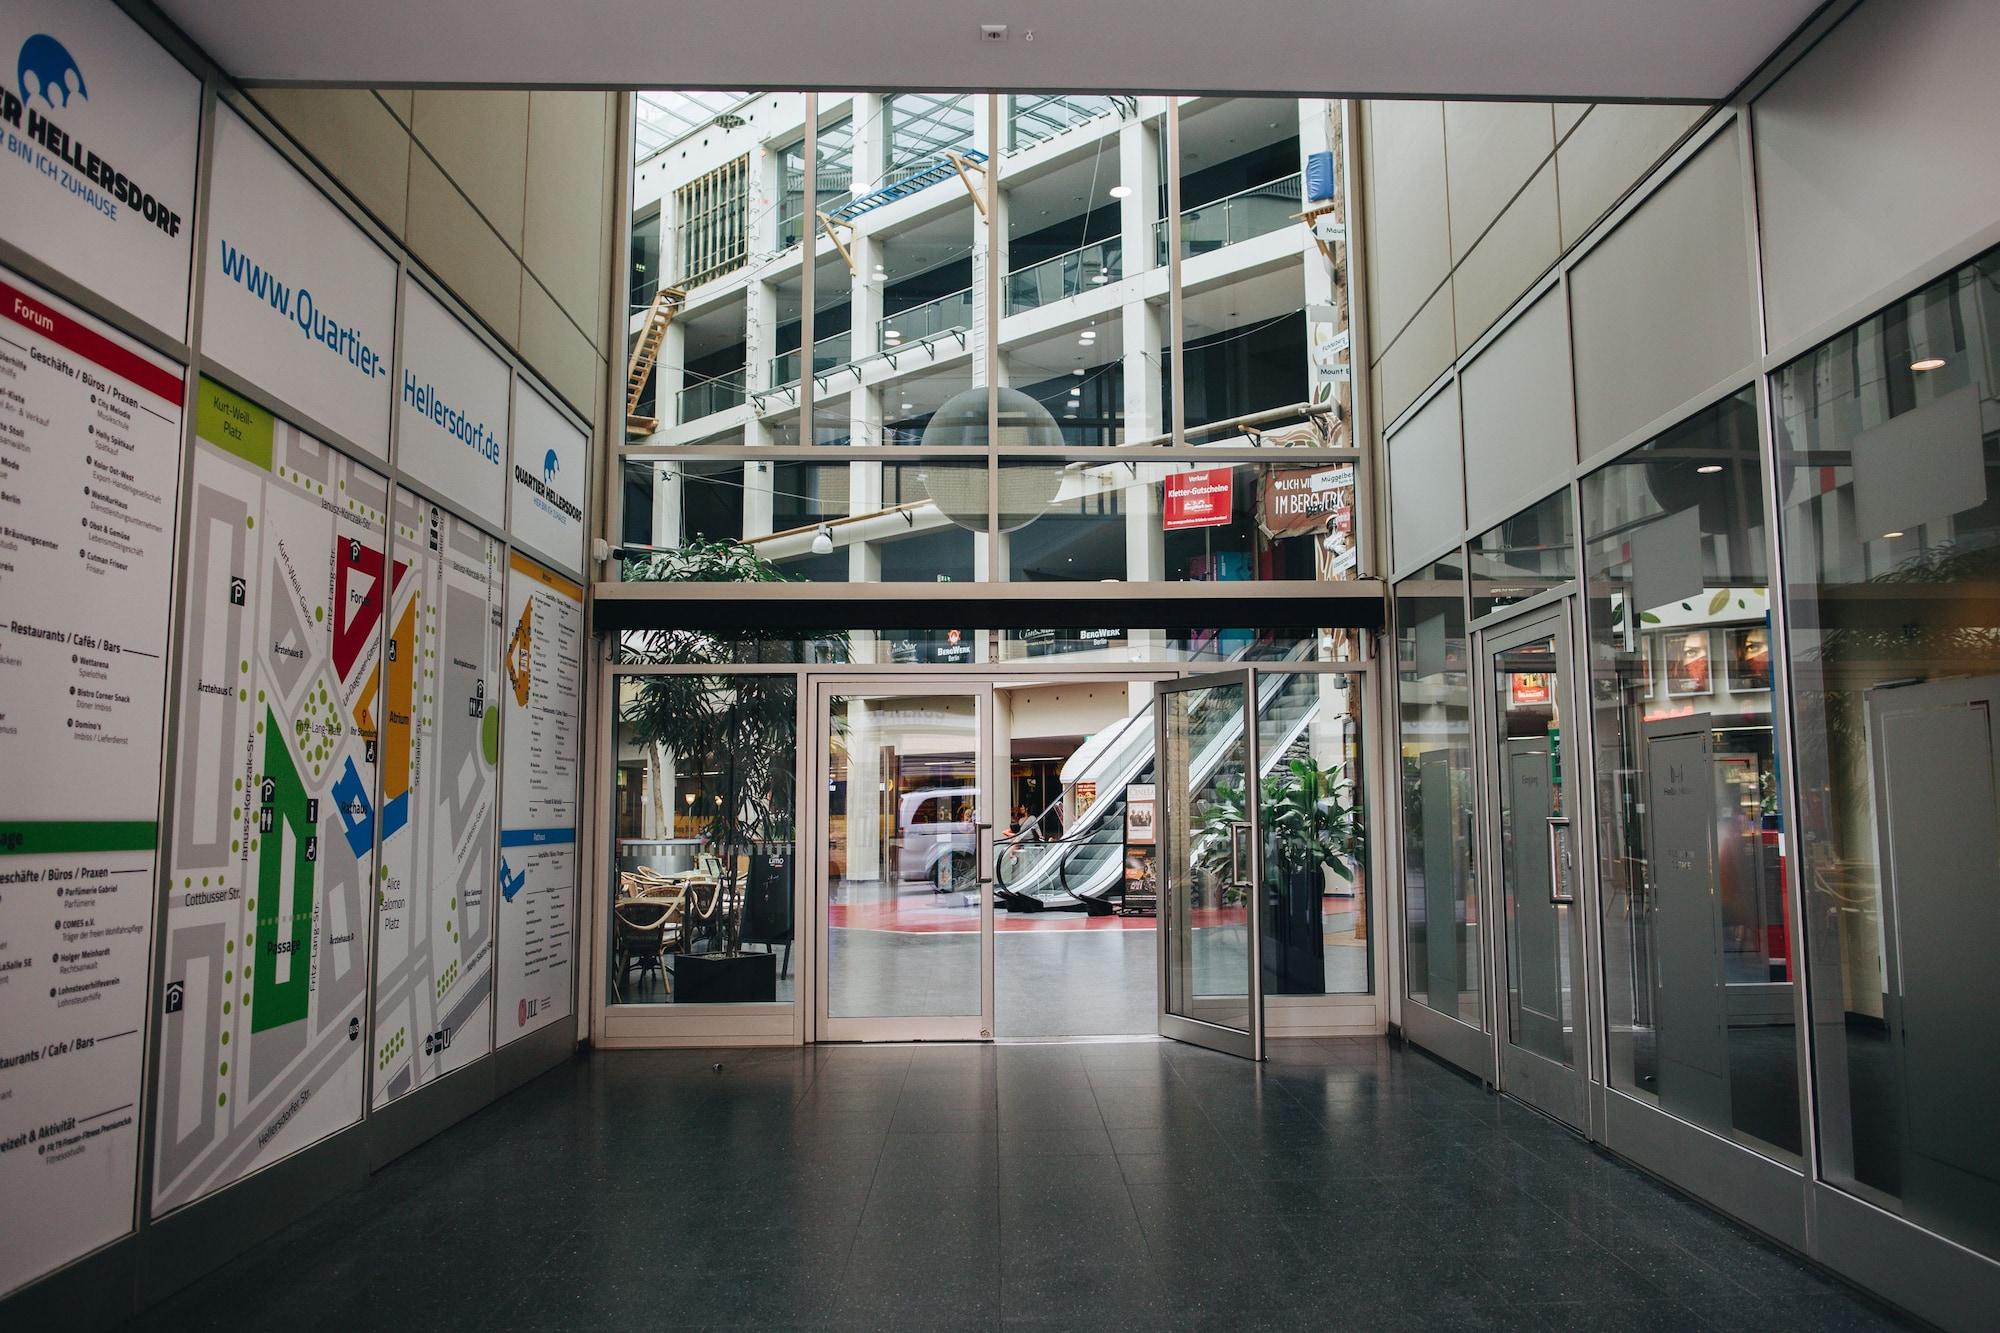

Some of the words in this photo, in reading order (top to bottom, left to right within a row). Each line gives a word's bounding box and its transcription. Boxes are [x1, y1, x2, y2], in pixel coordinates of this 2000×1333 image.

[8, 134, 33, 165] BIN
[36, 153, 59, 182] ICH
[60, 169, 119, 222] ZUHAUSE
[28, 107, 182, 239] HELLERSDORF
[14, 298, 54, 332] Forum
[221, 239, 386, 379] www.Quartier-
[30, 346, 74, 378] Geschäfte
[75, 368, 81, 381] /
[82, 371, 105, 393] Büros
[112, 387, 139, 410] Praxen
[1320, 368, 1344, 376] Mount
[213, 396, 254, 426] Kurt-Weill-
[404, 369, 499, 466] Hellersdorf.de
[223, 422, 242, 442] Platz
[1, 456, 20, 471] Mode
[109, 465, 135, 483] Ost-West
[1189, 474, 1208, 483] Verkauf
[515, 464, 545, 499] QUARTIER
[545, 486, 582, 523] HELLERSDORF
[1168, 484, 1229, 499] Kletter-Gutscheine
[1283, 478, 1300, 491] LICH
[0, 491, 21, 505] Berlin
[1275, 495, 1288, 515] IM
[1290, 490, 1345, 514] BERGWERK
[4, 527, 59, 551] Bräunungscenter
[89, 521, 102, 533] Obst
[109, 527, 131, 543] Gemüse
[109, 558, 129, 572] Friseur
[278, 539, 314, 630] Kurt-Weill-Gasse
[351, 589, 370, 606] Forum
[10, 620, 65, 644] Restaurants
[73, 634, 96, 650] Cafés
[103, 639, 121, 654] Bars
[1093, 638, 1107, 646] Berlin
[77, 688, 95, 699] Bistro
[95, 690, 114, 702] Corner
[114, 693, 131, 704] Snack
[198, 680, 228, 697] Ärztehaus
[75, 719, 102, 731] Domino's
[389, 711, 409, 725] Atrium
[296, 719, 342, 738] Fritz-Lang-Platz
[357, 728, 377, 738] Standort
[241, 730, 254, 862] Janusz-Korczak-Str.
[342, 801, 367, 815] Rathaus
[48, 867, 73, 882] Büros
[81, 867, 109, 879] Praxen
[65, 886, 97, 898] Parfümerie
[98, 884, 118, 895] Gabriel
[386, 877, 400, 891] Alice
[185, 890, 228, 907] Cottbusser
[228, 887, 240, 901] Str.
[62, 918, 84, 930] COMES
[85, 918, 95, 928] e.V.
[384, 917, 400, 931] Platz
[267, 939, 301, 956] Passage
[310, 901, 320, 992] Fritz-Lang-Str.
[23, 958, 32, 968] SE
[60, 952, 80, 965] Holger
[81, 948, 110, 960] Meinhardt
[58, 977, 120, 996] Lohnsteuerhilfeverein
[527, 998, 537, 1020] JLL
[48, 1043, 68, 1057] Cafe
[75, 1036, 94, 1050] Bars
[258, 1099, 300, 1150] Hellersdorfer
[300, 1089, 311, 1104] Str.
[29, 1130, 36, 1143] &
[38, 1117, 76, 1141] Aktivität
